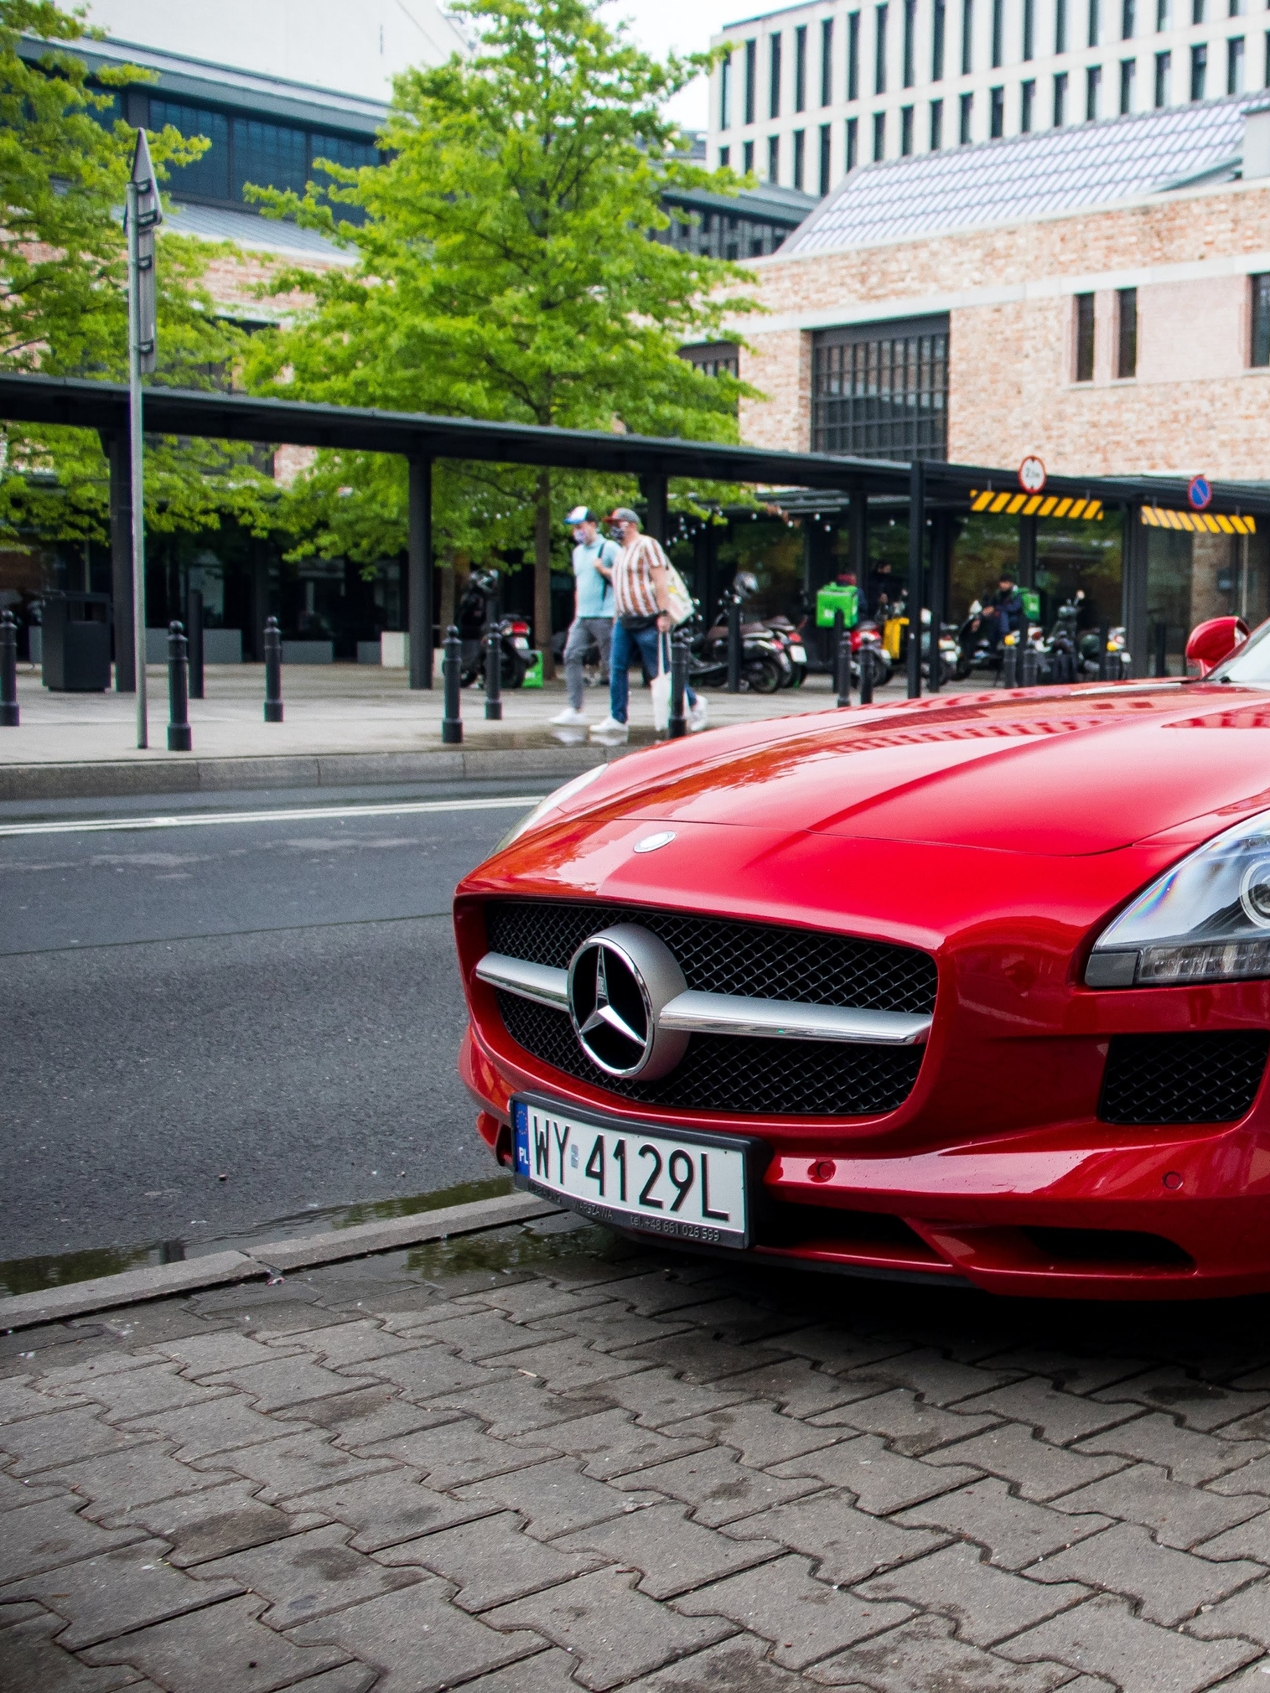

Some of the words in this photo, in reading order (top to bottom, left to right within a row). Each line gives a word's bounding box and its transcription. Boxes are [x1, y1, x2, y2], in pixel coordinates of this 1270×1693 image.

[518, 1147, 529, 1165] PL
[533, 1115, 571, 1185] WY
[585, 1132, 730, 1222] 4129L
[645, 1216, 662, 1231] +48
[663, 1219, 679, 1234] 661
[682, 1223, 699, 1238] 026
[701, 1228, 720, 1242] 599
